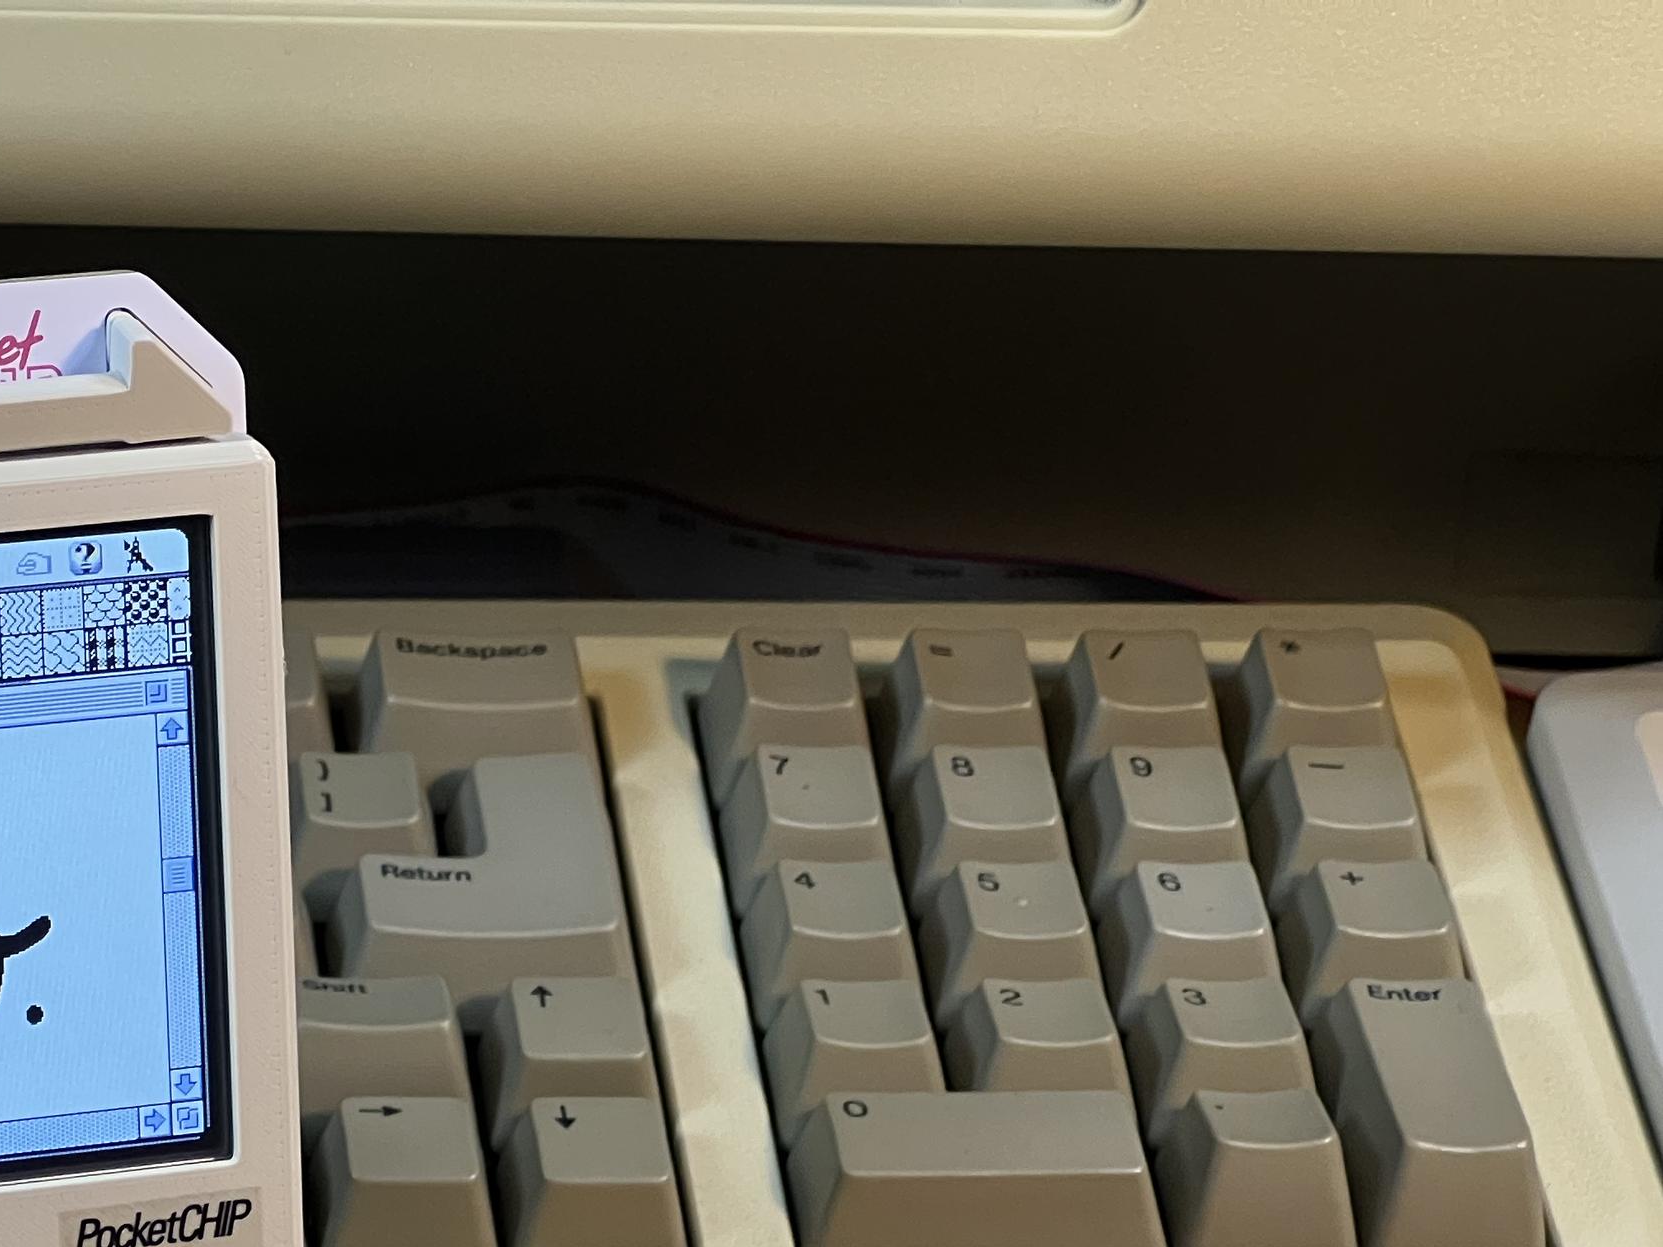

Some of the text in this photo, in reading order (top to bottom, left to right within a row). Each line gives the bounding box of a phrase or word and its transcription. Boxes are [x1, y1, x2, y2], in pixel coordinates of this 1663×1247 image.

[395, 637, 548, 660] Backspace
[751, 639, 822, 660] Clear
[769, 754, 791, 776] 7
[951, 755, 975, 777] 8
[1130, 756, 1153, 777] 9
[380, 862, 472, 884] Return
[794, 871, 816, 890] 4
[977, 871, 1000, 893] 5
[1157, 872, 1182, 893] 6
[999, 987, 1024, 1007] 2
[1183, 987, 1207, 1007] 3
[1366, 982, 1443, 1003] Enter
